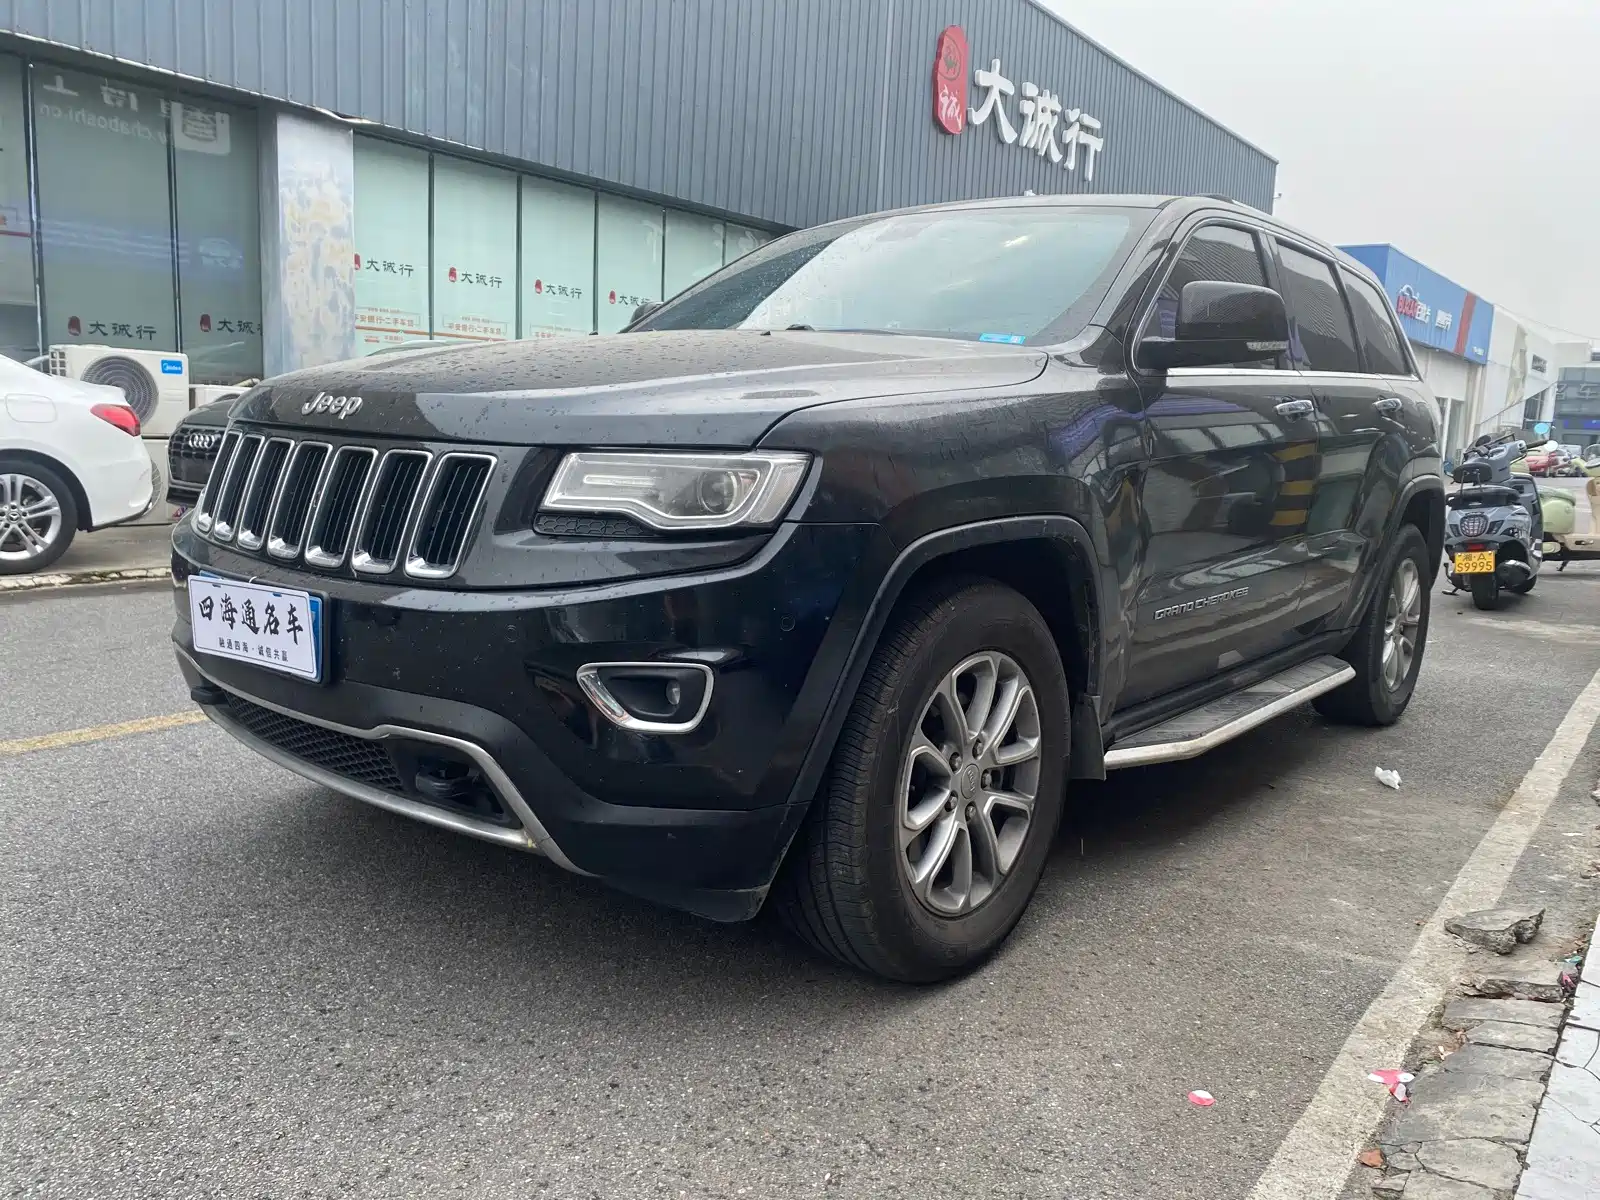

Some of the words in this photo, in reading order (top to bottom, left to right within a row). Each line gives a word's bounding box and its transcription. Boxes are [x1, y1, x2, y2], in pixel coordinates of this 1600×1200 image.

[967, 59, 1104, 182] 大诚行
[365, 257, 414, 277] 大诚行
[460, 271, 502, 288] 大诚行
[545, 284, 582, 299] 大诚行
[88, 320, 157, 341] 大诚行
[217, 318, 261, 334] 大诚
[301, 391, 363, 420] Jeep
[1457, 561, 1493, 573] S9995
